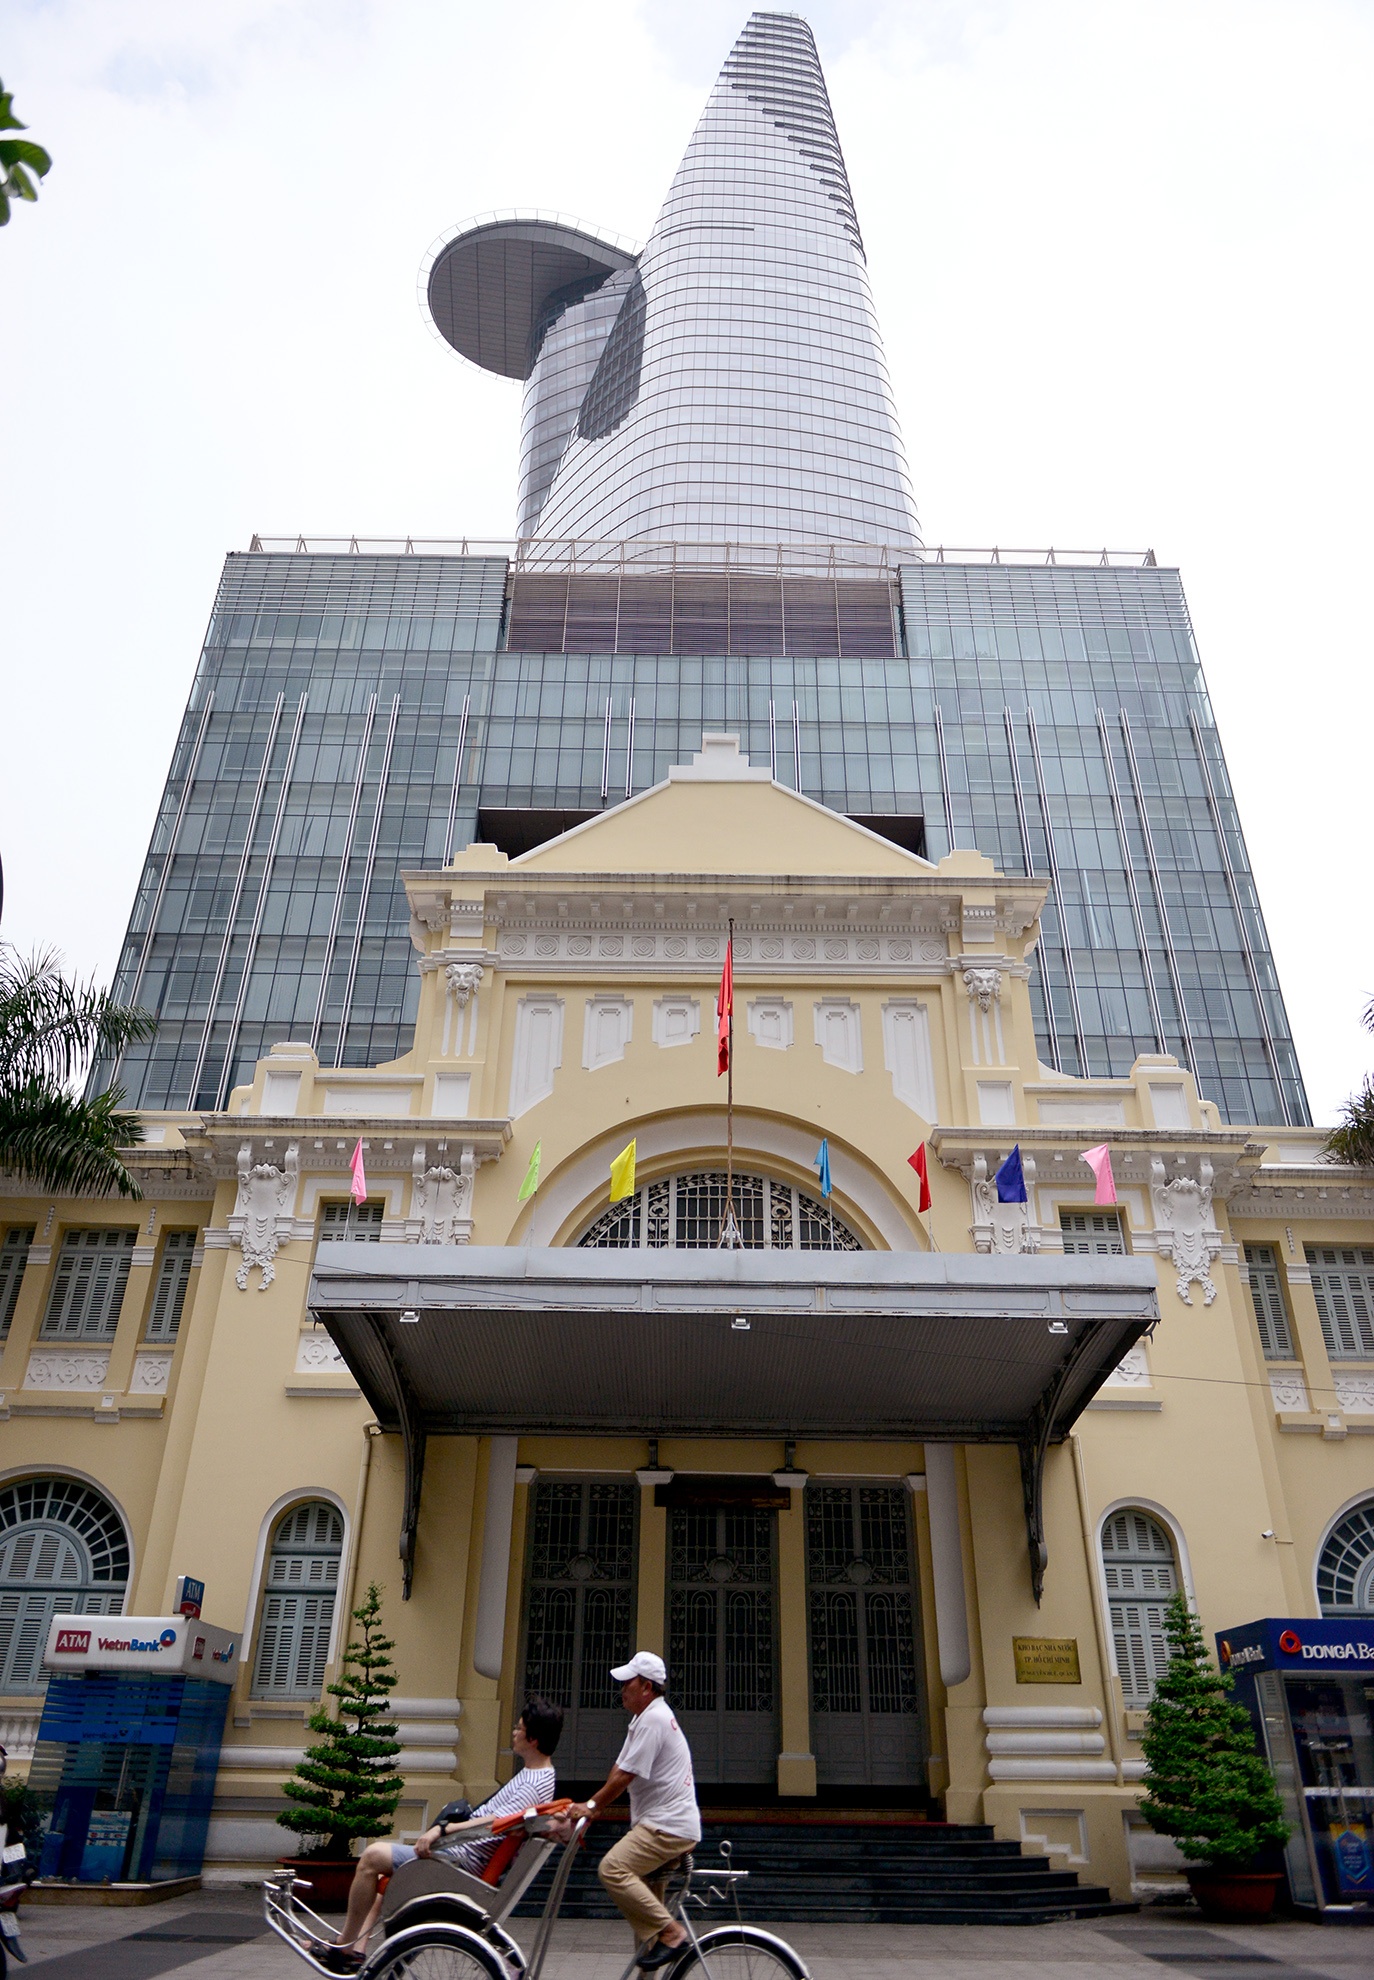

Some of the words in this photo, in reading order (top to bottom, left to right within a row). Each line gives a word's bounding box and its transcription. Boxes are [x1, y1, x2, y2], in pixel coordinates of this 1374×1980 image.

[185, 1581, 201, 1601] ATM
[58, 1634, 89, 1648] ATM
[98, 1638, 161, 1652] VietinBank
